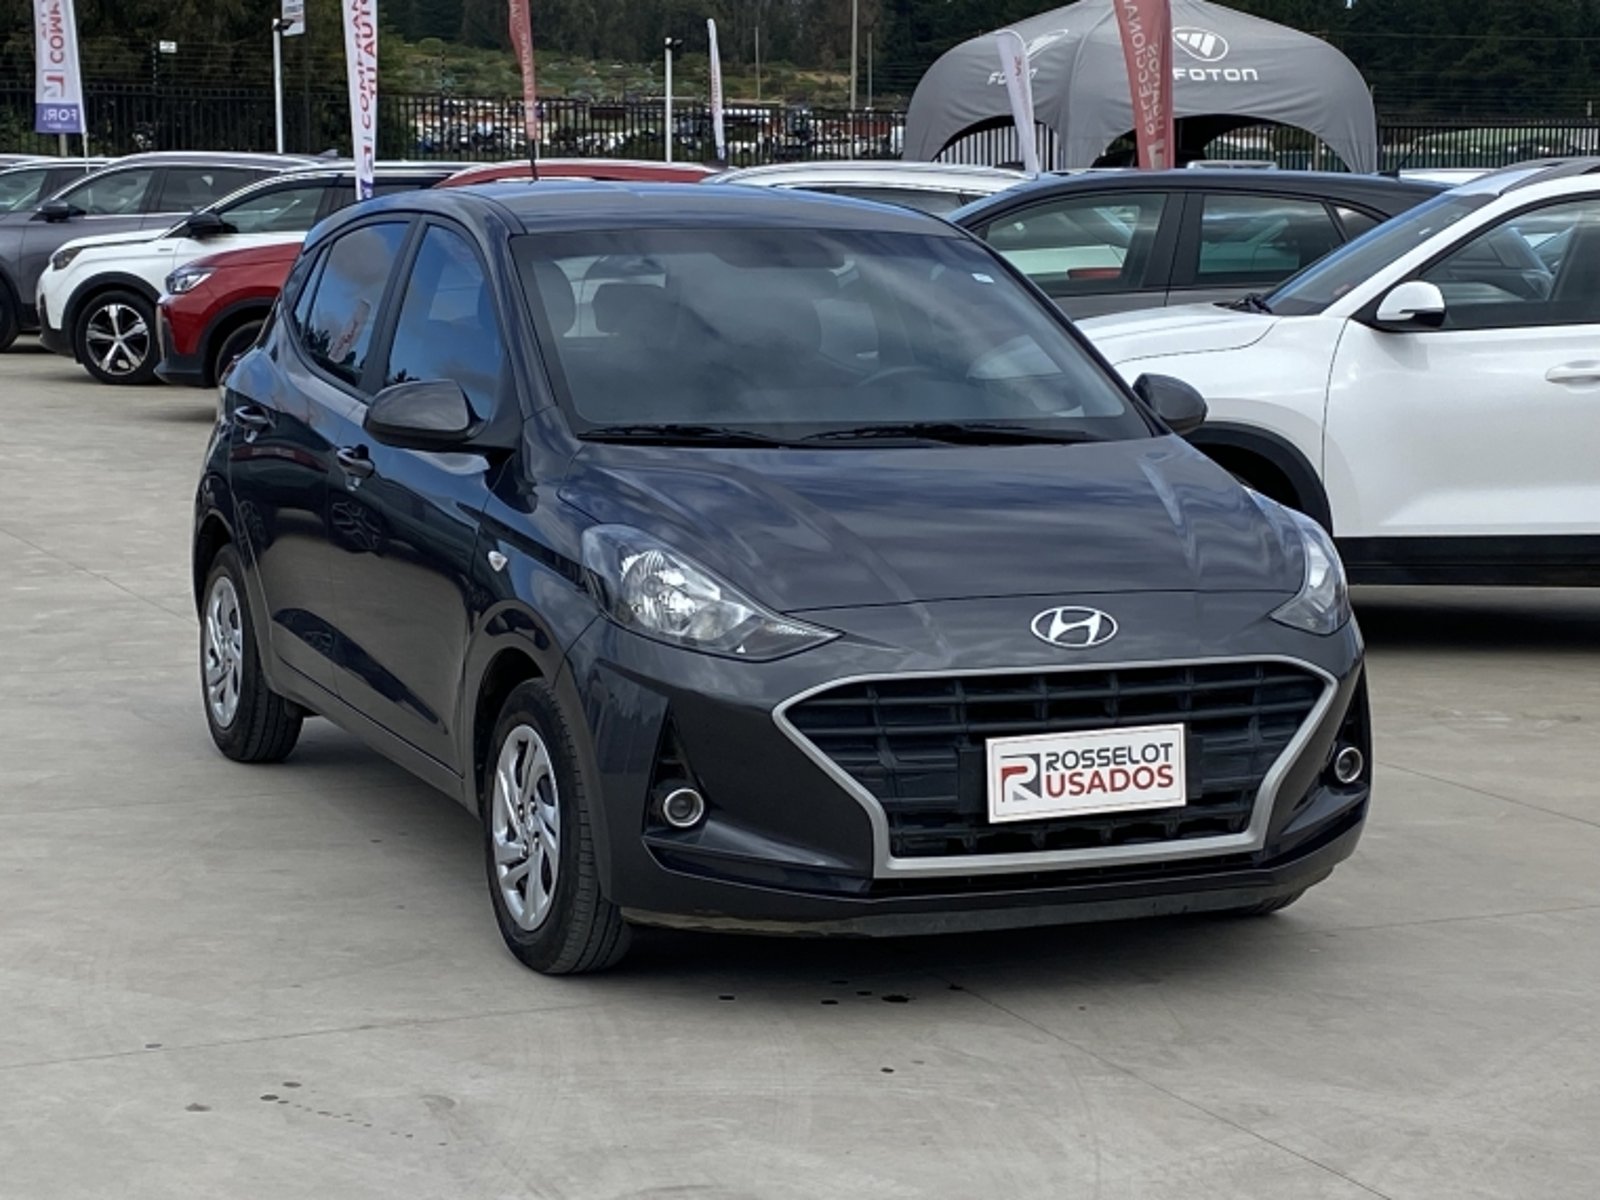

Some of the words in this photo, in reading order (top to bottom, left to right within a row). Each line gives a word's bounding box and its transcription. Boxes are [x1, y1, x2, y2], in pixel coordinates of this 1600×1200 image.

[1172, 68, 1259, 81] FOTON
[1046, 743, 1173, 772] ROSSELOT
[1046, 764, 1174, 798] USADOS
